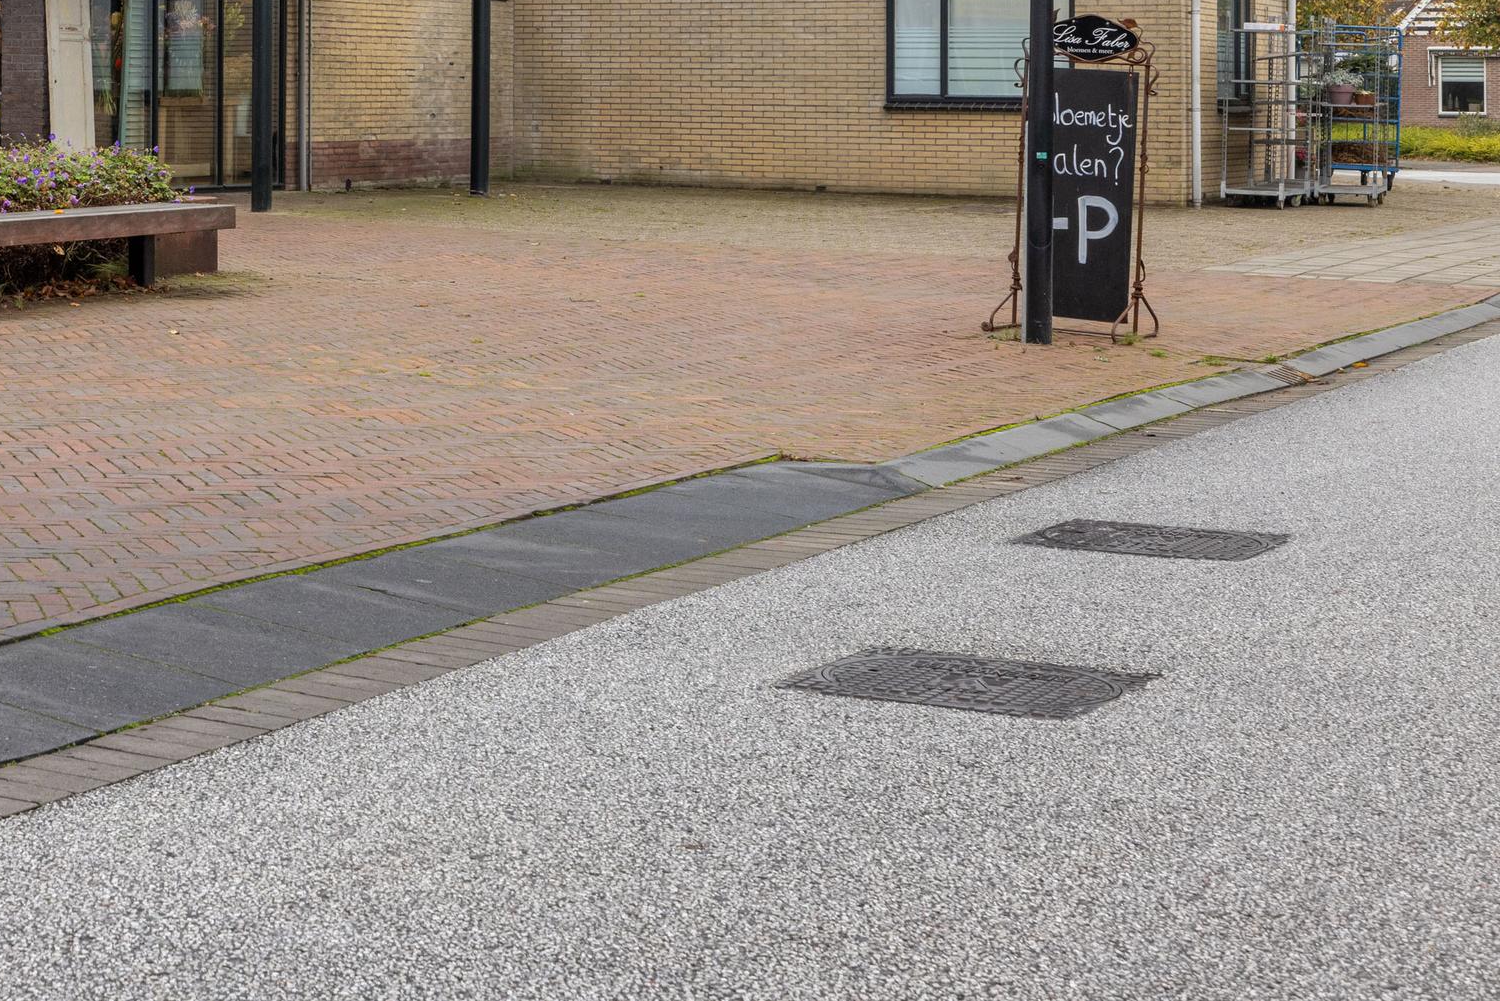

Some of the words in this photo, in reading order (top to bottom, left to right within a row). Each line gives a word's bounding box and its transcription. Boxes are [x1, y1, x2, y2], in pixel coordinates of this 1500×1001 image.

[1053, 24, 1082, 44] Lisa
[1085, 27, 1130, 48] Faber
[1053, 92, 1133, 146] loemetje
[1054, 143, 1124, 187] alen?
